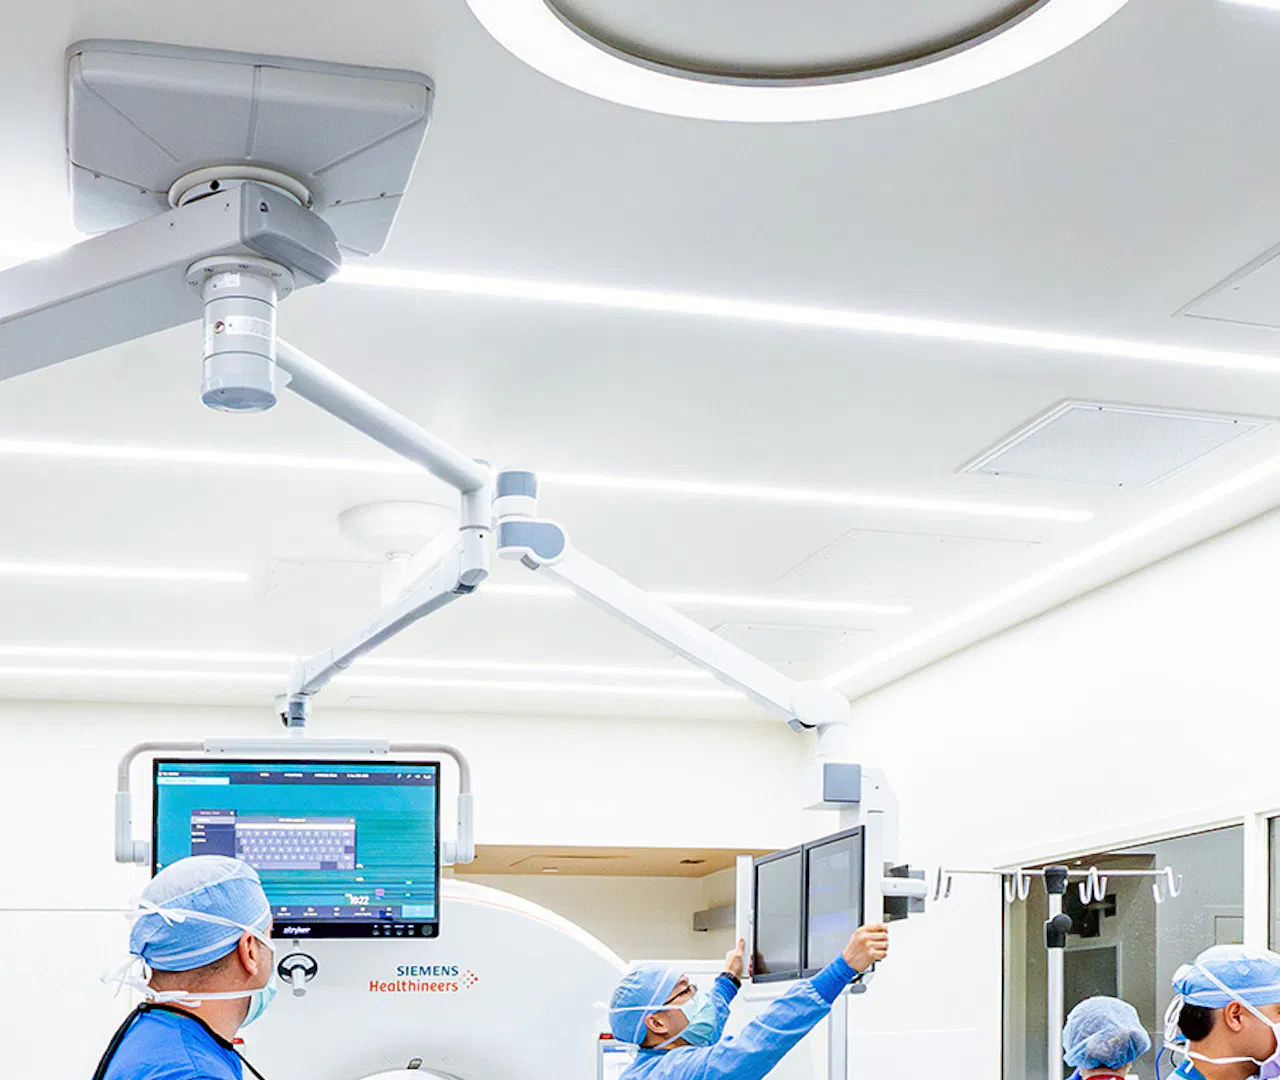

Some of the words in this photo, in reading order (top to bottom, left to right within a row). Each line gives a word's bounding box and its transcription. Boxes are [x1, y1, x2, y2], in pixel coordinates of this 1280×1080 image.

[282, 925, 312, 935] stryker
[396, 965, 459, 977] SIEMENS
[369, 979, 459, 992] Healthineers
